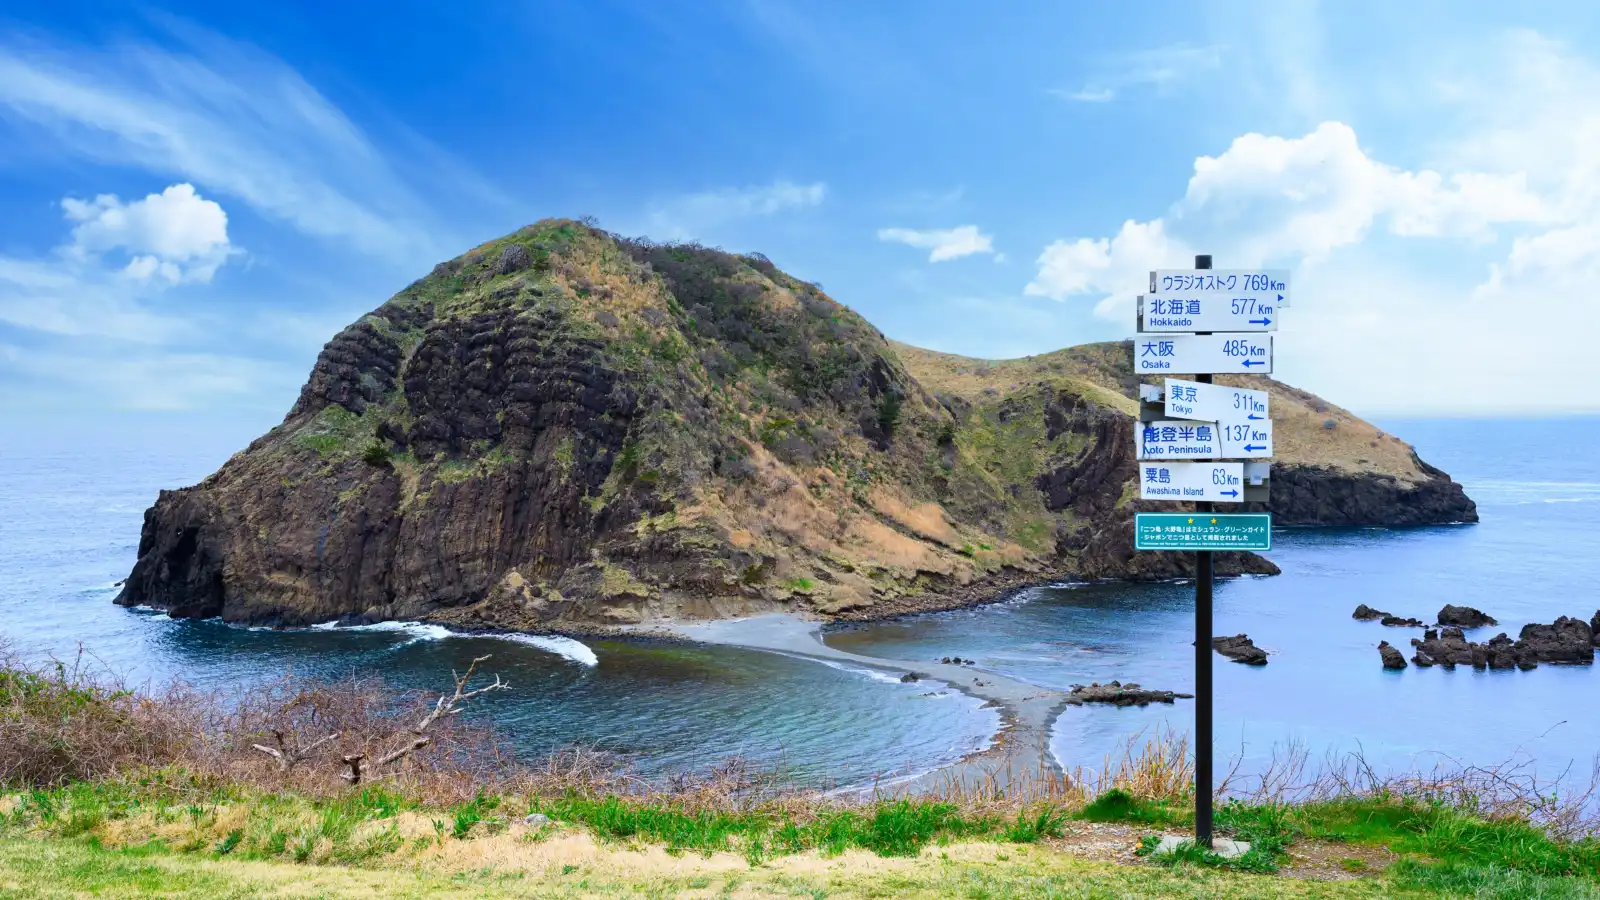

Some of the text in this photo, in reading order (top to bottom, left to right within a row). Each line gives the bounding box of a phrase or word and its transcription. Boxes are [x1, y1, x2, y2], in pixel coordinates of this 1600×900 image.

[1163, 275, 1237, 291] ウラジオストク
[1150, 299, 1201, 315] 北海道
[1150, 317, 1192, 327] Hokkaido
[1141, 341, 1175, 357] 大阪
[1141, 360, 1171, 369] Osaka
[1171, 384, 1198, 403] 東京
[1171, 403, 1193, 415] Tokyo
[1143, 425, 1212, 443] 能登半島
[1168, 445, 1212, 454] Peninsula
[1145, 467, 1171, 484] 粟島
[1146, 486, 1204, 496] Awashima Island
